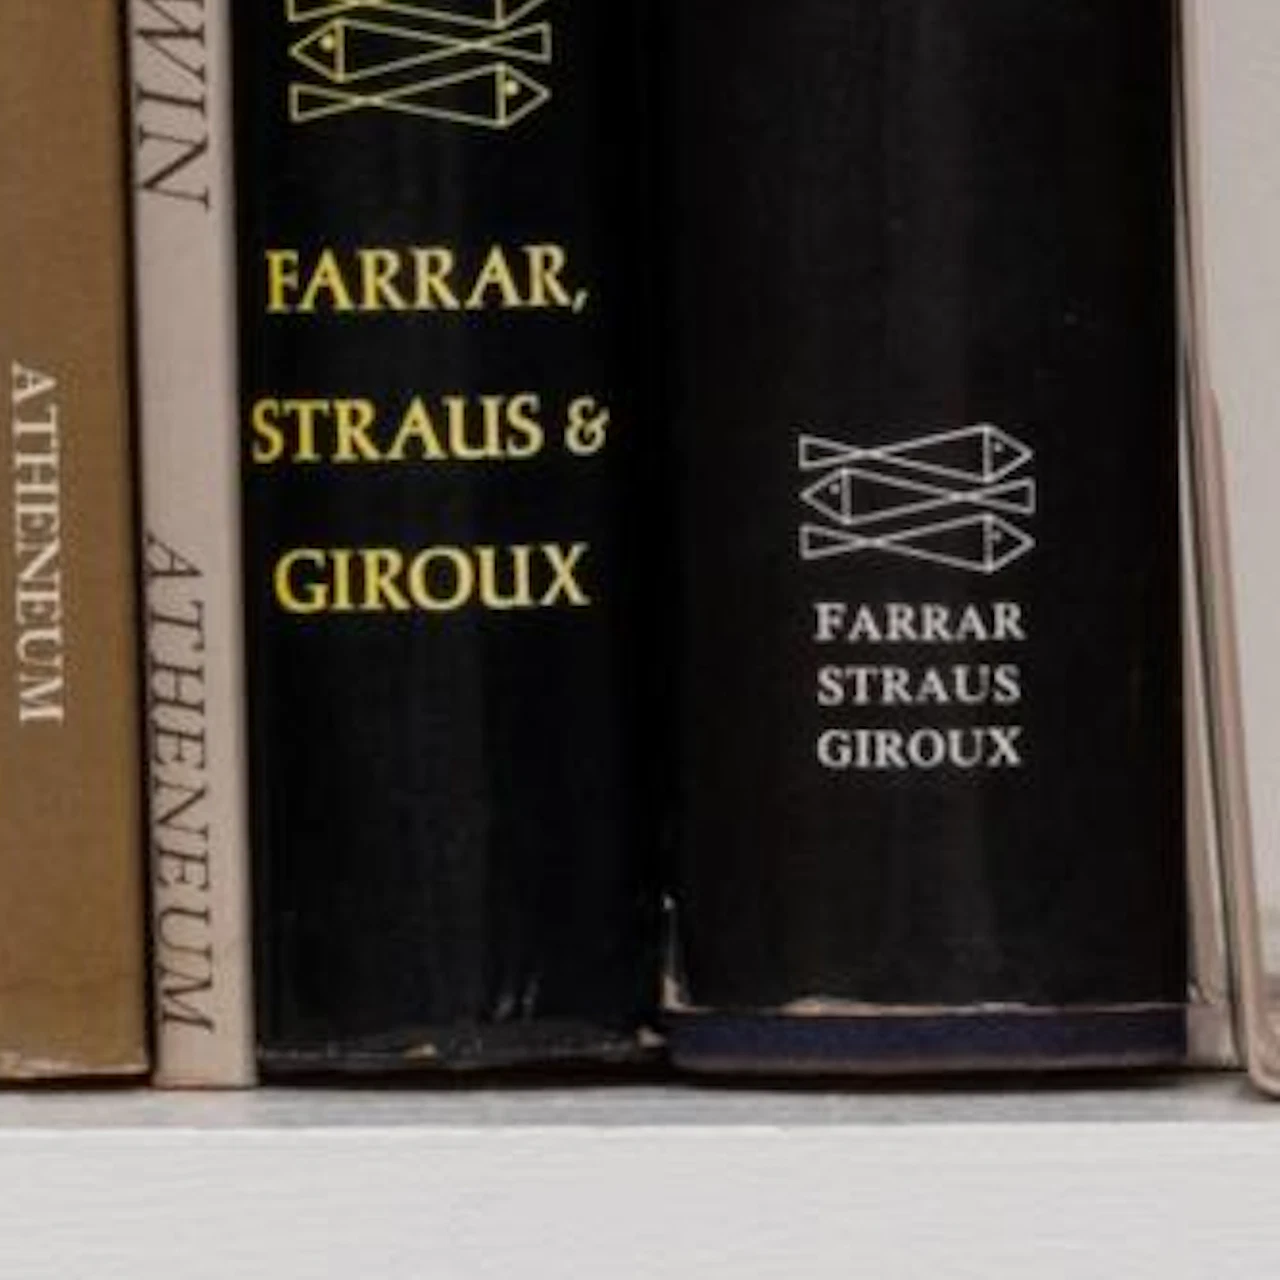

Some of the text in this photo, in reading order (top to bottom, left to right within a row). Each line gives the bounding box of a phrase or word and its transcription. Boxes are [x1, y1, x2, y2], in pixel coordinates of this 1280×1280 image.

[264, 244, 589, 314] FARRAR,
[251, 393, 611, 464] STRAUS &
[11, 360, 66, 727] ATHENEUM
[272, 541, 591, 614] GIROUX
[813, 602, 1027, 642] FARRAR
[816, 664, 1022, 706] STRAUS
[816, 726, 1023, 769] GIROUX
[145, 532, 216, 1035] ATHENEUM
